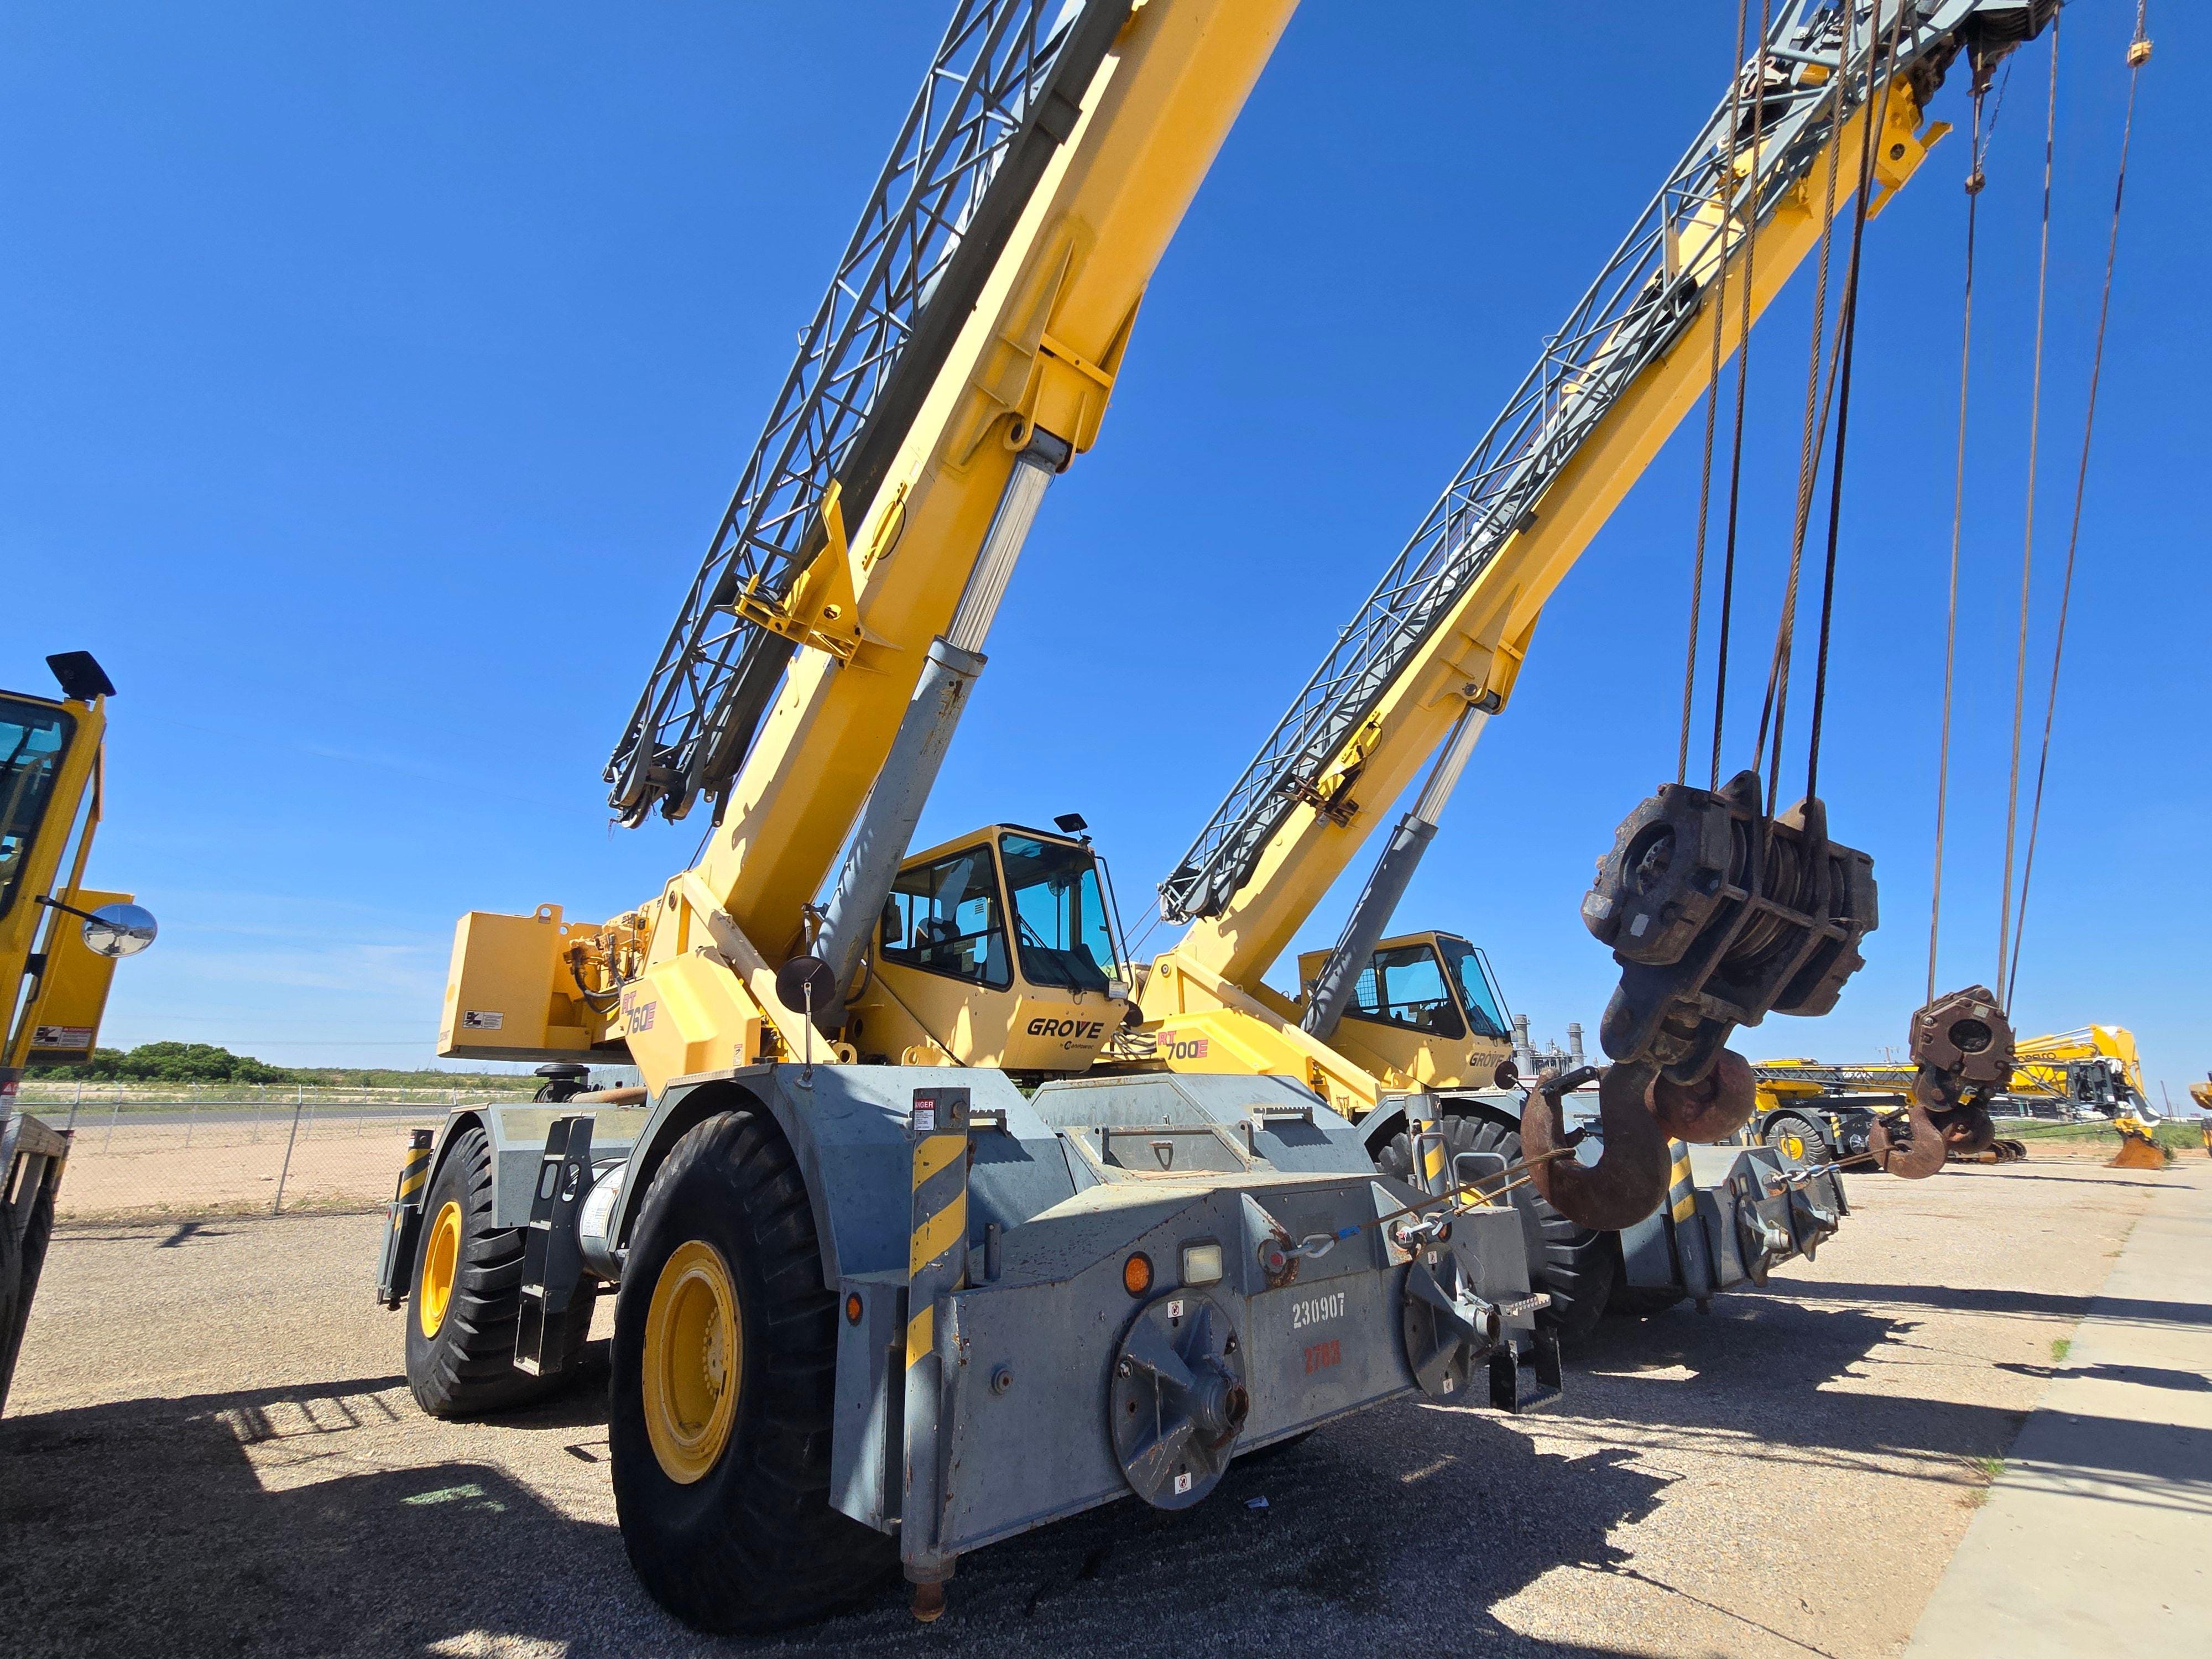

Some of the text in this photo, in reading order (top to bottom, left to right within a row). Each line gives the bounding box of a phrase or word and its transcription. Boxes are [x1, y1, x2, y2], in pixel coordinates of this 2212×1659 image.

[622, 990, 637, 1015] RT
[626, 1001, 657, 1036] 760E
[1027, 1018, 1104, 1039] GROVE
[1157, 1030, 1177, 1046] RT
[1166, 1040, 1208, 1060] 700E
[1292, 1292, 1345, 1329] 230907
